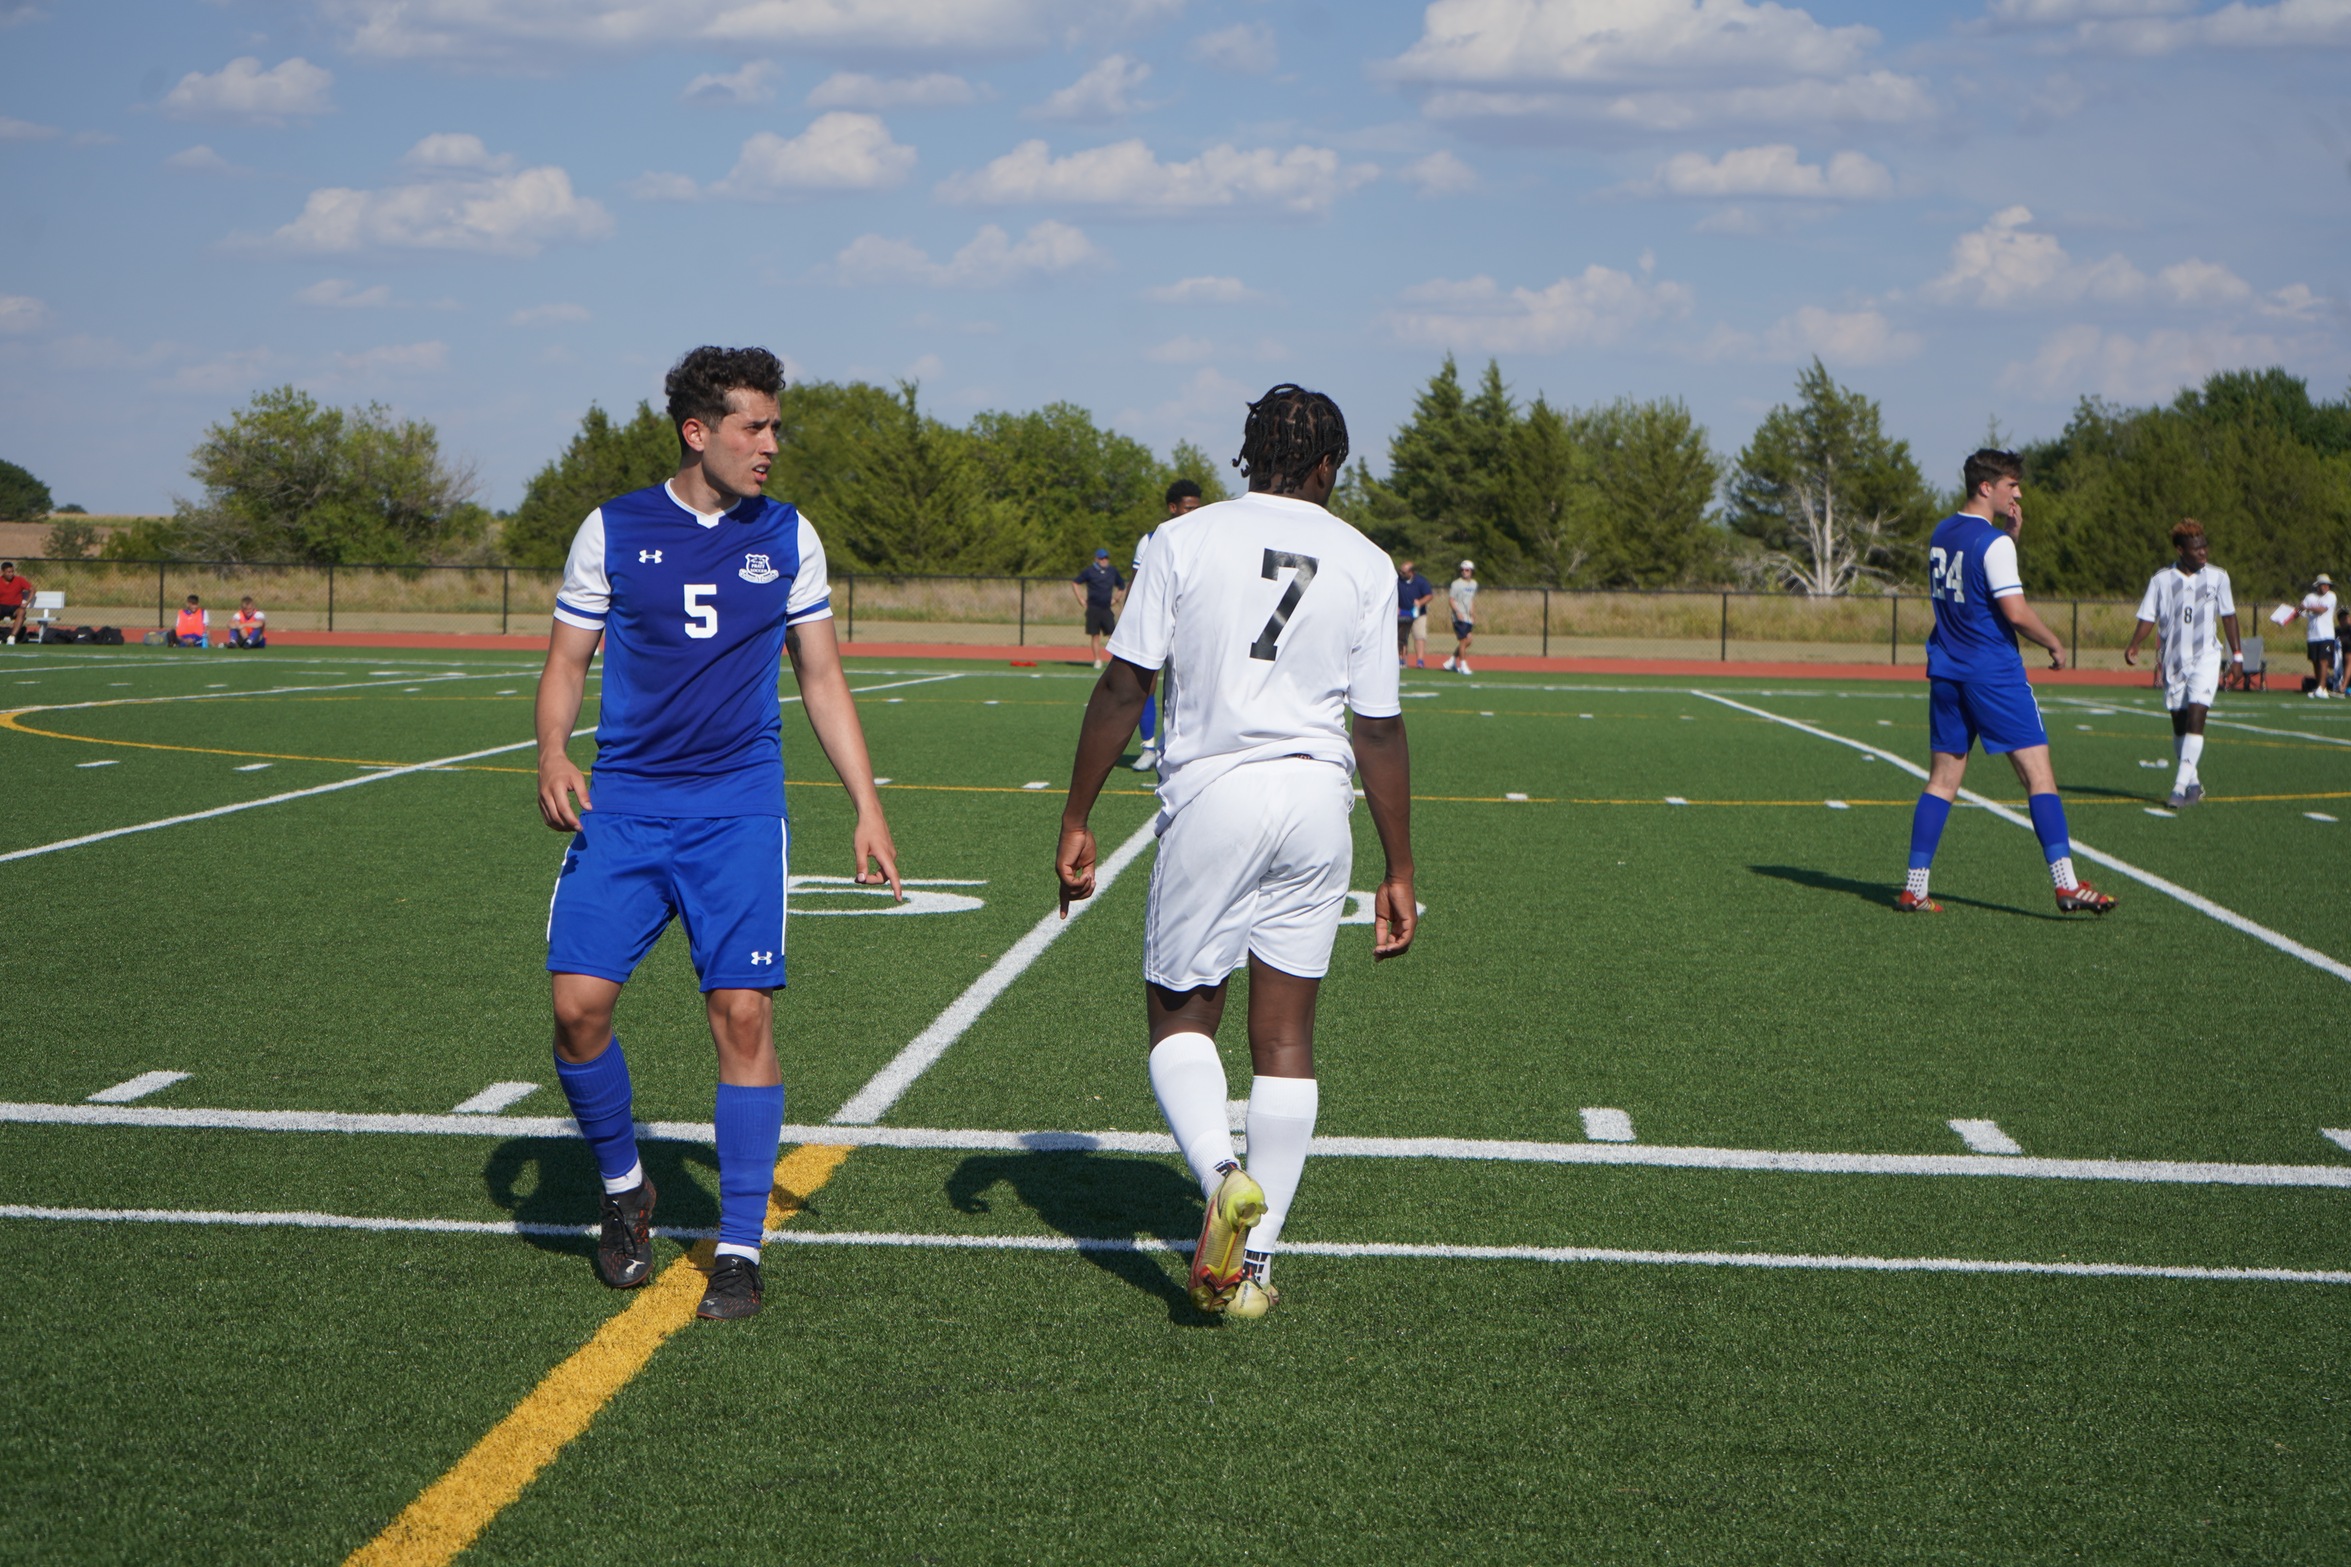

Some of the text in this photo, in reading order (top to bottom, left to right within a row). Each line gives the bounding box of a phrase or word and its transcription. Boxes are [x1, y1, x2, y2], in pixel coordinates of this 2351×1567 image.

[1929, 546, 1965, 604] 24
[683, 584, 718, 639] 5
[1249, 547, 1320, 662] 7
[2184, 606, 2193, 624] 8
